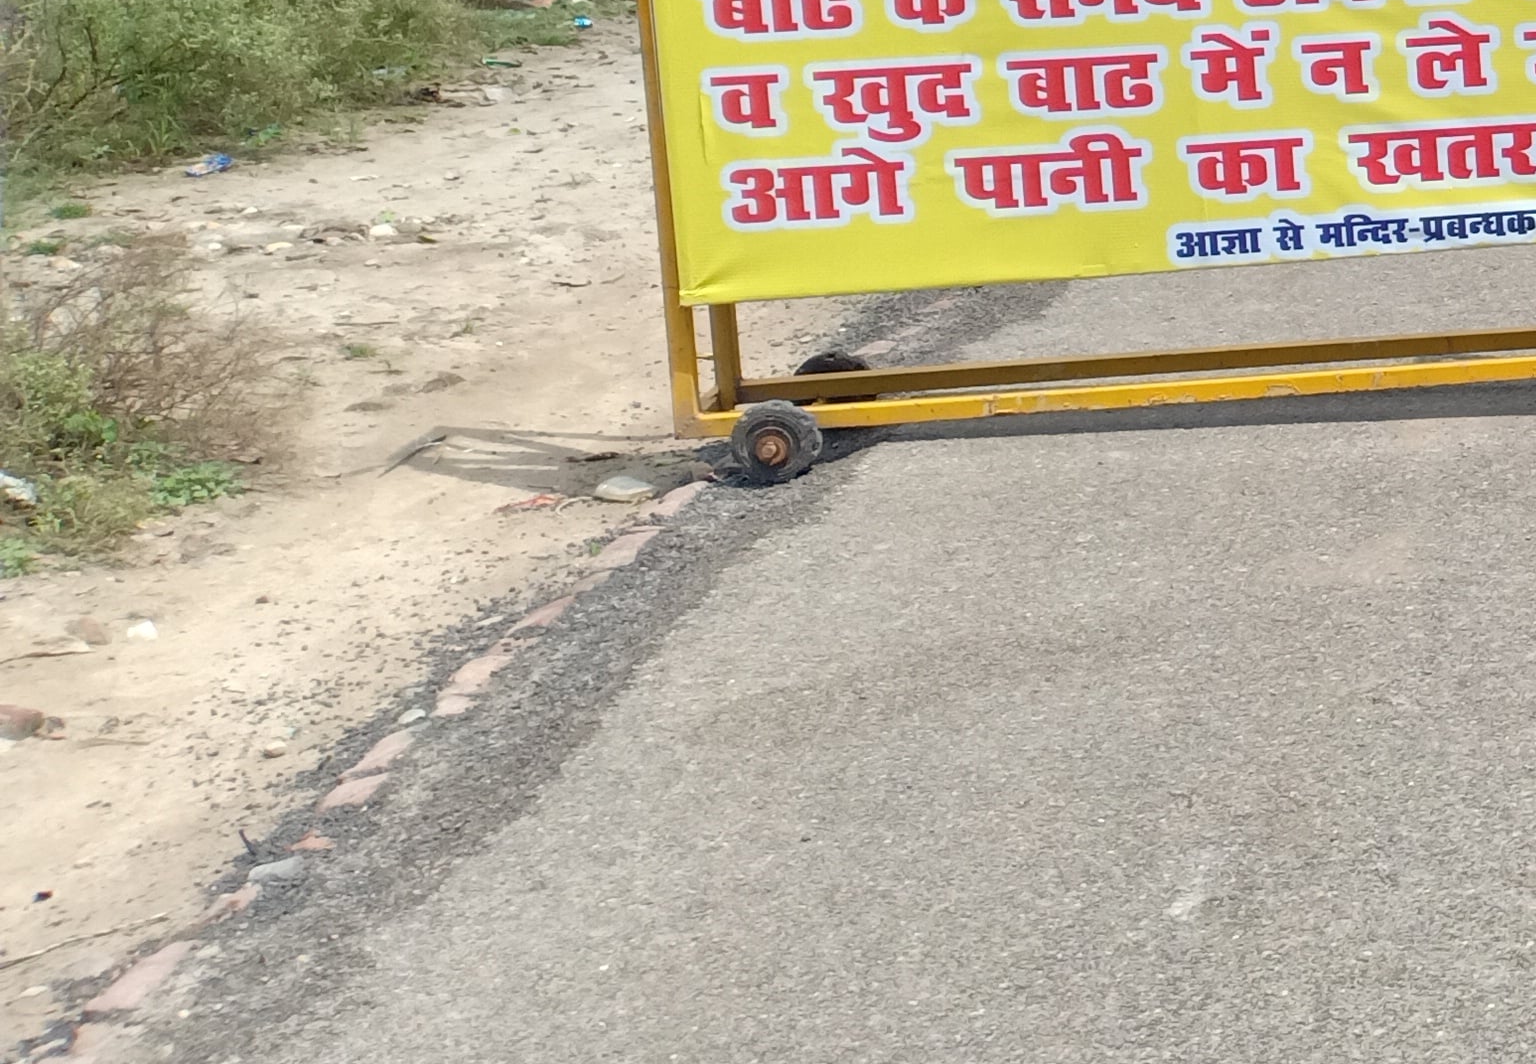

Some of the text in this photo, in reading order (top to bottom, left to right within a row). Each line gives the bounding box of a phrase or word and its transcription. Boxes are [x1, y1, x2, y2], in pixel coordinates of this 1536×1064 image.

[711, 74, 779, 129] व
[813, 63, 972, 142] खुद
[1006, 53, 1158, 112] बाढ
[1190, 28, 1270, 101] में
[1301, 41, 1371, 95] न
[1406, 19, 1490, 90] ले
[731, 148, 905, 223] आगे
[955, 134, 1141, 208] पानी
[1187, 138, 1303, 195] का
[1175, 227, 1263, 258] आज्ञा
[1272, 218, 1305, 251] से
